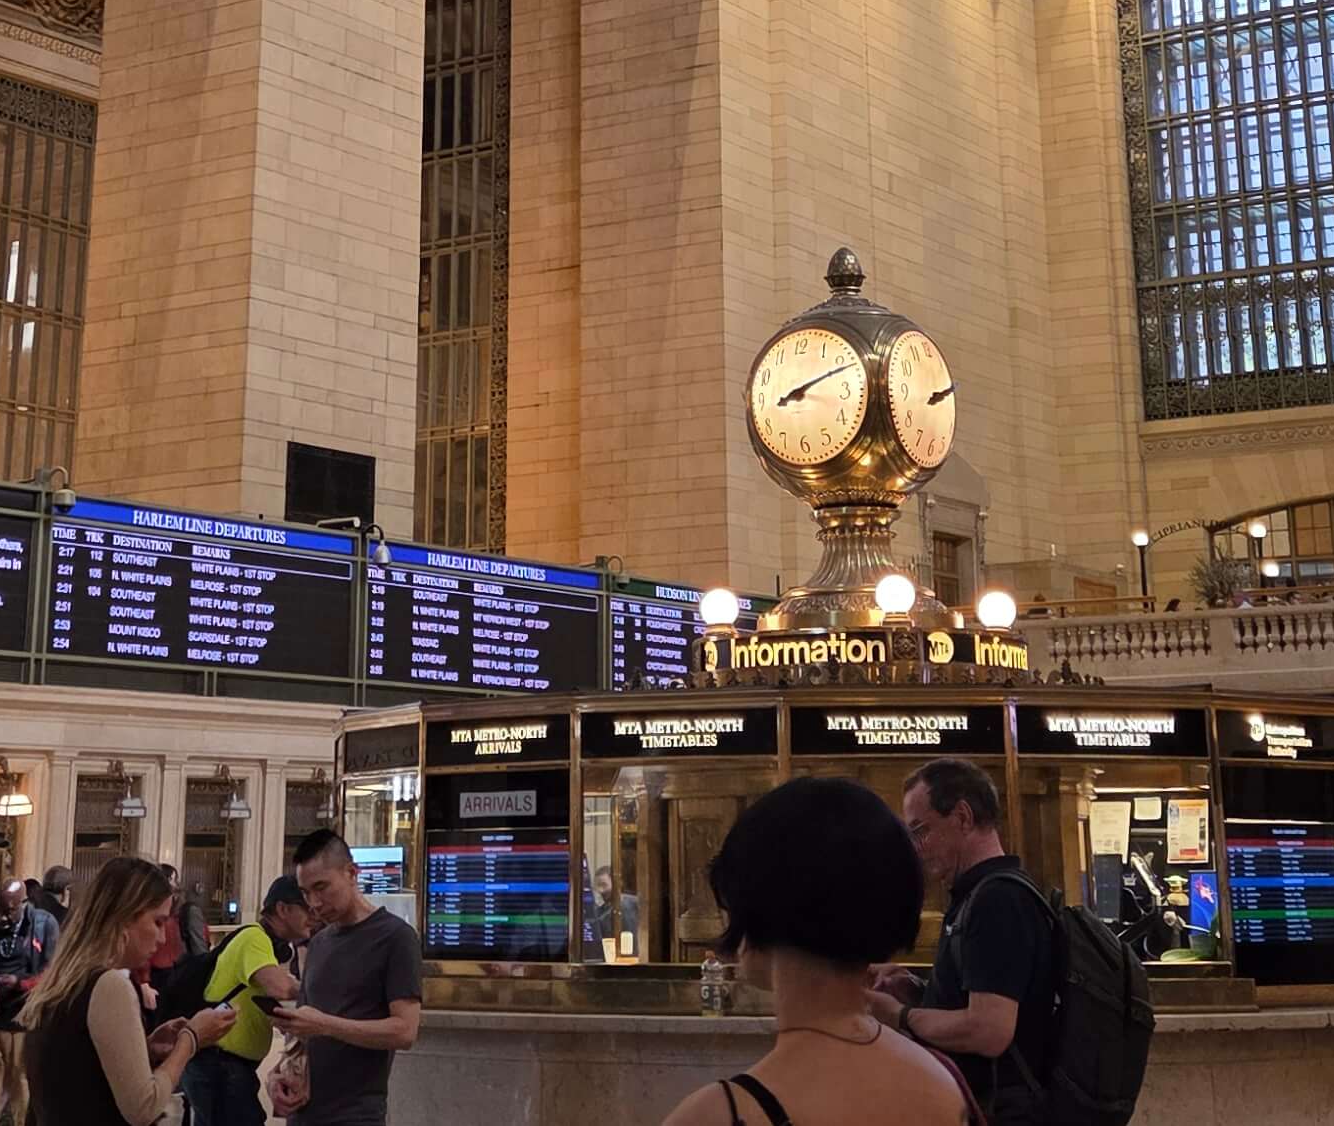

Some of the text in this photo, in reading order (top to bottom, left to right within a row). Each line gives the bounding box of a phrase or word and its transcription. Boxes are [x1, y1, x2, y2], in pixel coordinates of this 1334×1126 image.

[795, 339, 807, 354] 12
[821, 343, 826, 358] 1
[910, 345, 920, 362] 11
[776, 349, 785, 366] 11
[901, 359, 911, 377] 10
[761, 369, 770, 386] 10
[839, 382, 851, 399] 3
[901, 384, 908, 401] 9
[759, 393, 764, 410] 9
[836, 407, 848, 425] 4
[905, 410, 912, 427] 8
[765, 418, 772, 435] 8
[780, 432, 787, 449] 7
[800, 435, 810, 453] 6
[822, 428, 831, 446] 5
[917, 430, 923, 447] 7
[927, 439, 935, 456] 6
[133, 510, 286, 545] HARLEM LINE DEPARTURES
[52, 527, 230, 560] TIME TRK DESTINATION REMARKS
[13, 559, 21, 570] in
[112, 552, 158, 567] SOUTHEAST
[191, 562, 214, 574] WHITE
[215, 564, 239, 578] PLAINS
[245, 569, 256, 579] 1ST
[257, 571, 276, 581] STOP
[428, 552, 546, 581] HARLEM LINE DEPARTURES
[121, 571, 145, 583] WHITE
[146, 574, 172, 587] PLAINS
[190, 579, 224, 592] MELROSE
[230, 584, 242, 594] 1ST
[242, 585, 262, 596] STOP
[368, 568, 385, 579] TIME
[413, 574, 459, 589] DESTINATION
[110, 588, 156, 602] SOUTHEAST
[190, 597, 213, 609] WHITE
[214, 599, 238, 612] PLAINS
[243, 603, 255, 613] 1ST
[256, 604, 274, 615] STOP
[656, 586, 688, 602] HUDSON
[109, 606, 155, 620] SOUTHEAST
[189, 614, 212, 626] WHITE
[213, 616, 237, 629] PLAINS
[242, 620, 254, 630] 1ST
[255, 621, 274, 631] STOP
[109, 624, 136, 636] MOUNT
[137, 628, 160, 638] KISCO
[188, 632, 230, 645] SCARSDALE
[235, 636, 247, 646] 1ST
[248, 637, 267, 648] STOP
[117, 643, 141, 655] WHITE
[142, 645, 168, 657] PLAINS
[187, 649, 221, 662] MELROSE
[227, 653, 239, 663] 1ST
[240, 654, 259, 664] STOP
[730, 633, 886, 669] Information
[614, 719, 744, 735] MTA METRO-NORTH
[827, 716, 967, 731] MTA METRO-NORTH
[1048, 717, 1174, 733] MTA METRO-NORTH
[451, 725, 547, 743] MTA METRO-NORTH
[640, 733, 717, 748] TIMETABLES
[855, 730, 940, 744] TIMETABLES
[1074, 732, 1150, 747] TIMETABLES
[475, 740, 522, 755] ARRIVALS
[464, 795, 533, 812] ARRIVALS
